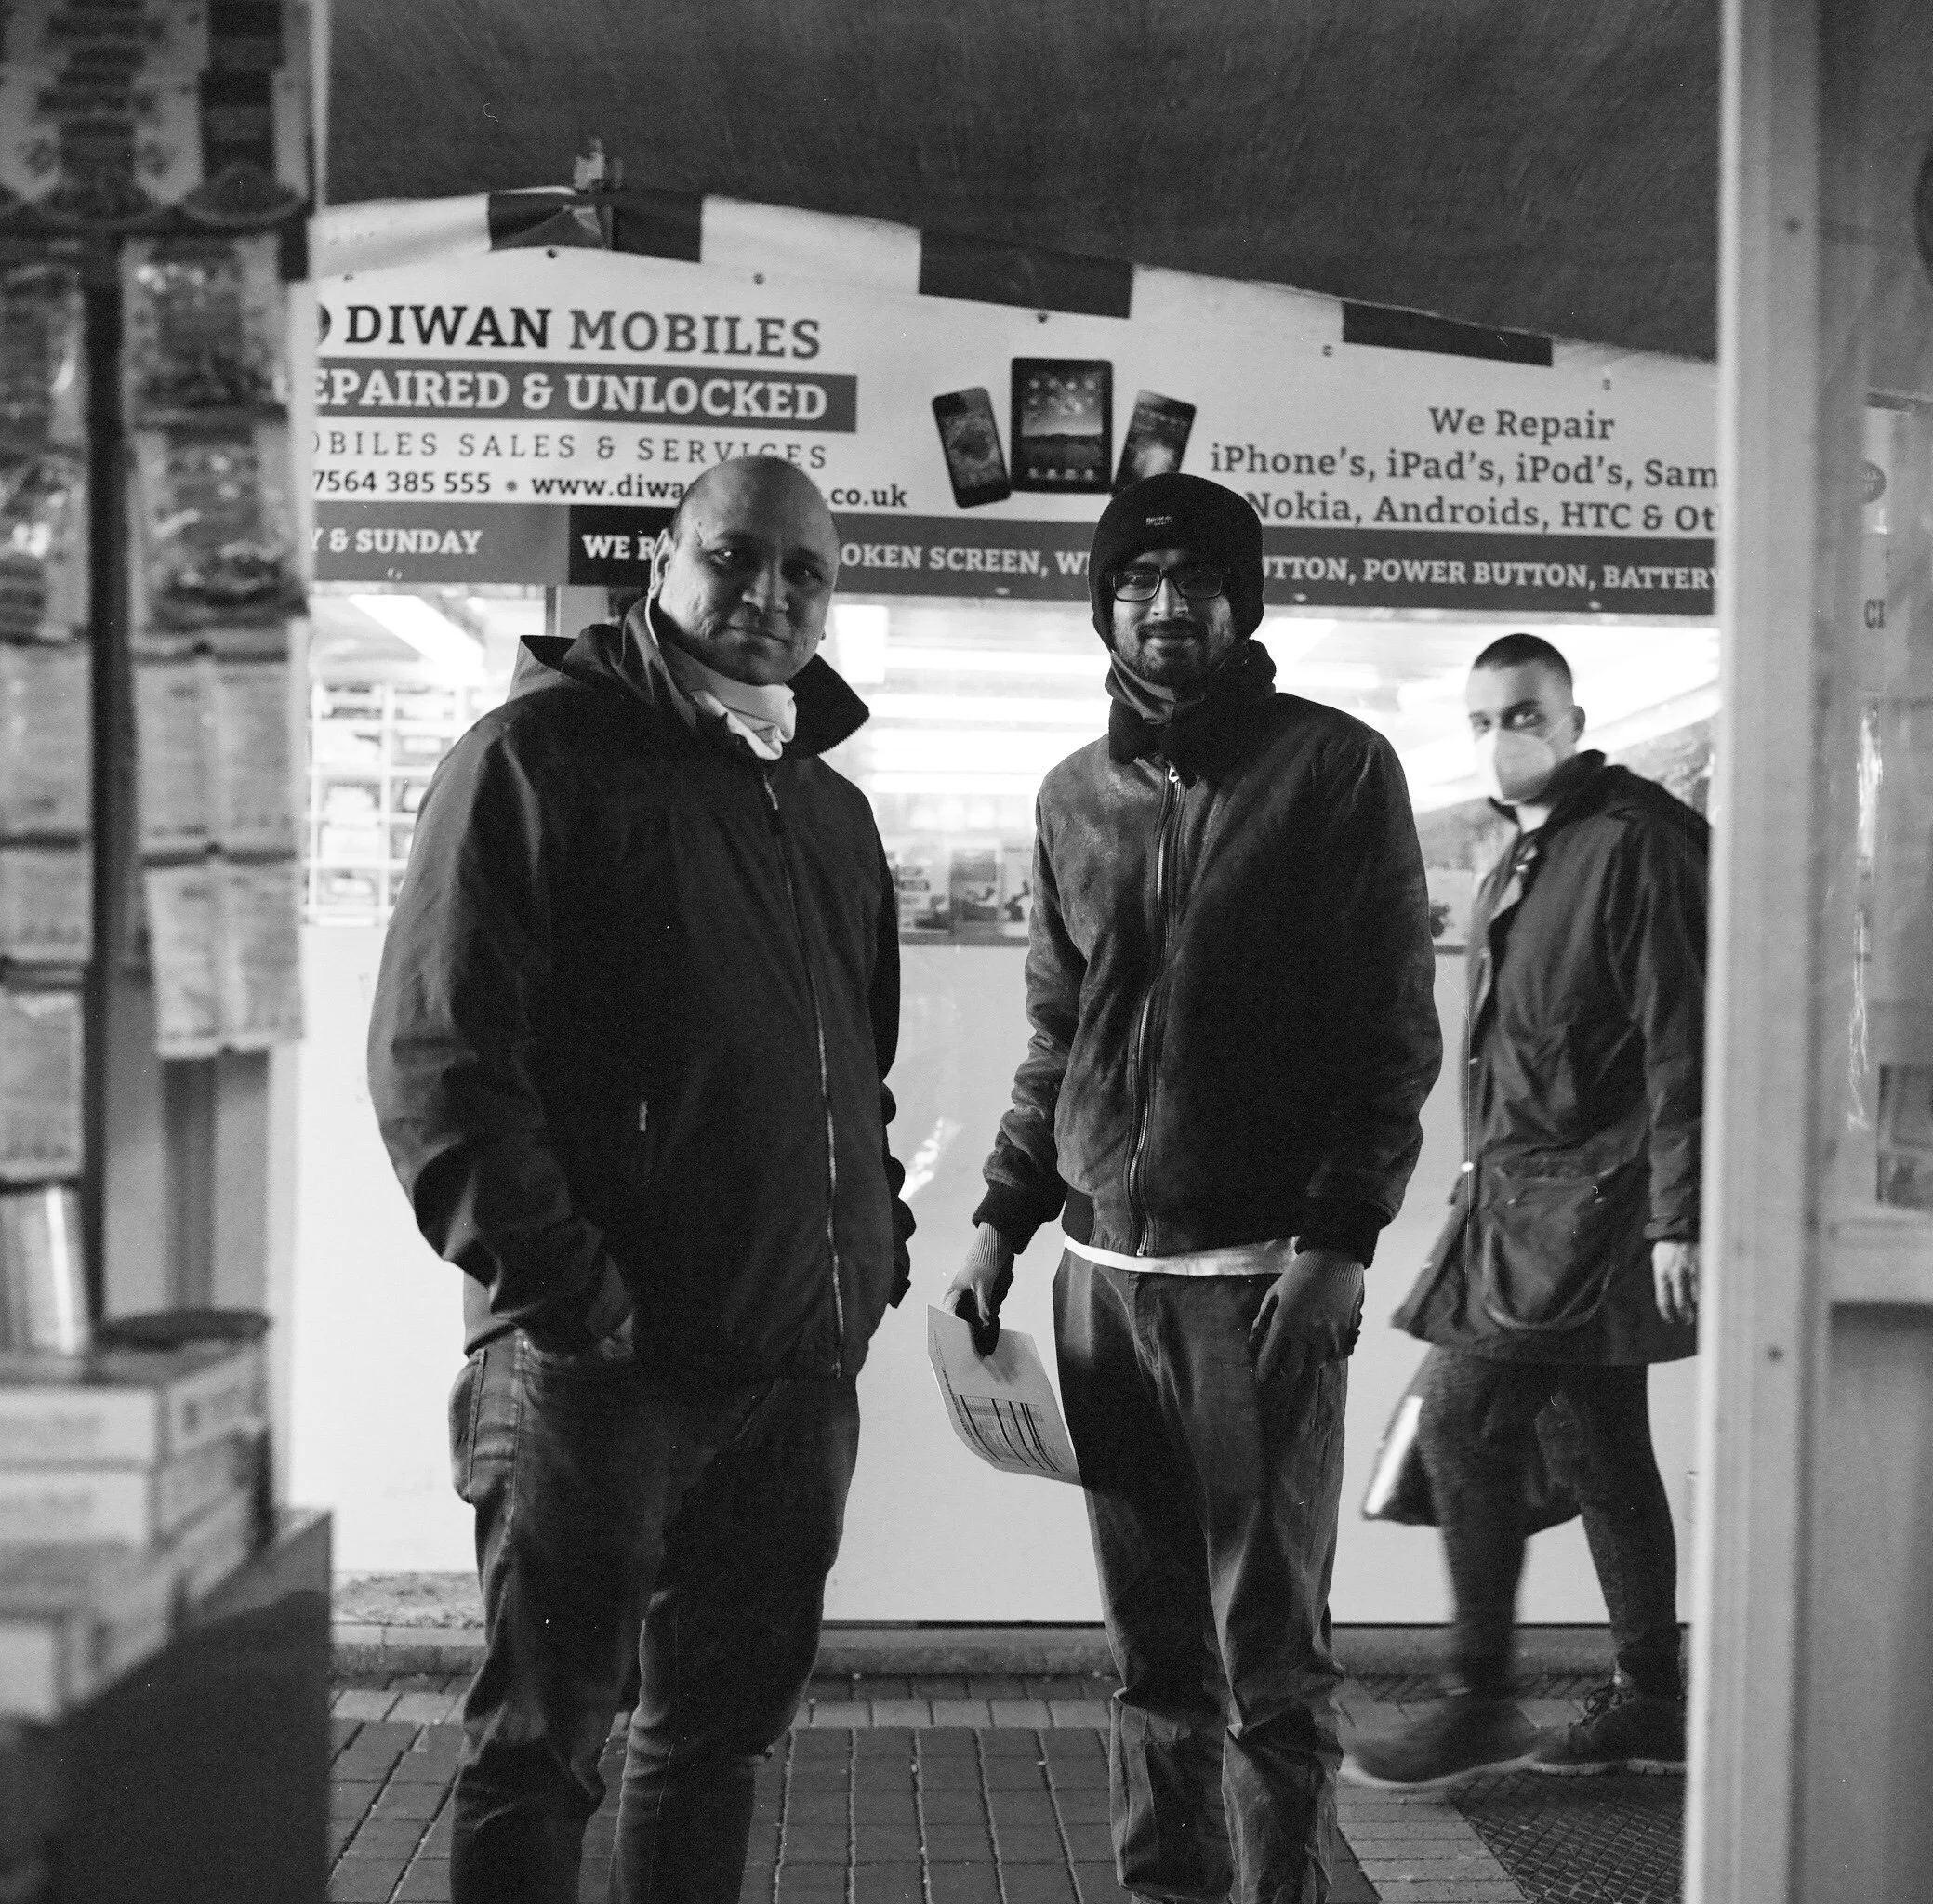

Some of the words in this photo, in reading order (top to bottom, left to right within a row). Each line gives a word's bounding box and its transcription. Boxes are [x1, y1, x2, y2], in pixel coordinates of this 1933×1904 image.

[345, 305, 551, 349] DIWAN
[568, 310, 821, 360] MOBILES
[314, 368, 510, 408] EPAIRED
[521, 372, 555, 411] &
[564, 374, 828, 420] UNLOCKED
[311, 431, 437, 456] BILES
[458, 433, 575, 459] SALES
[595, 435, 616, 461] &
[1429, 406, 1485, 436] We
[1495, 409, 1616, 446] Repair
[312, 469, 377, 493] 7564
[386, 470, 435, 494] 385
[443, 472, 492, 495] 555
[1211, 442, 1376, 483] iPhone's,
[1387, 447, 1504, 487] iPad's,
[1516, 452, 1633, 492] iPod's,
[1644, 458, 1718, 489] Sam
[1373, 495, 1550, 536] Androids,
[1562, 500, 1632, 531] HTC
[1642, 503, 1663, 531] &
[1675, 505, 1715, 532] Ot
[328, 527, 350, 554] &
[355, 527, 483, 555] SUNDAY
[581, 534, 631, 560] WE
[841, 542, 922, 569] OKEN
[929, 546, 1050, 578] SCREEN,
[1362, 558, 1466, 585] POWER
[1473, 561, 1596, 593] BUTTON,
